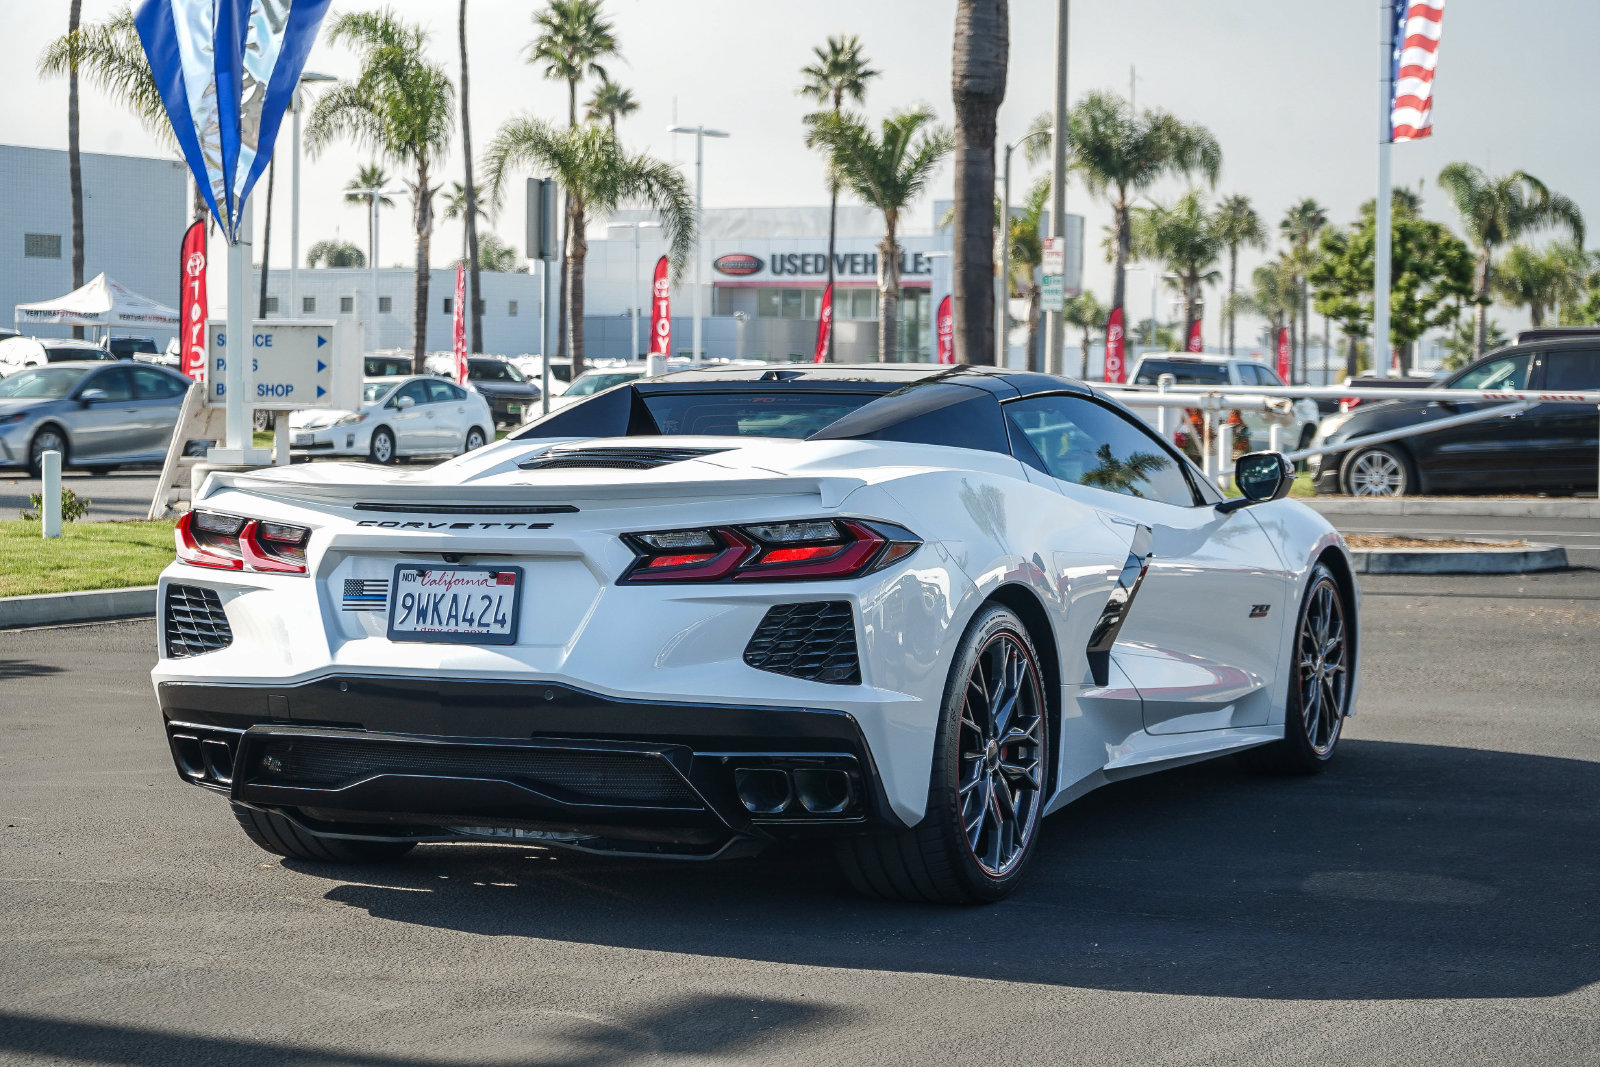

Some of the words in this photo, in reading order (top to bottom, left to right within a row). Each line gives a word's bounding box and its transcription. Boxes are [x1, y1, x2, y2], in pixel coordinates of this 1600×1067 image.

[770, 253, 827, 275] USED
[257, 384, 294, 397] SHOP
[356, 520, 554, 530] CORVETTE
[401, 572, 417, 583] NOV
[420, 570, 496, 592] California
[398, 592, 507, 629] 9WKA424
